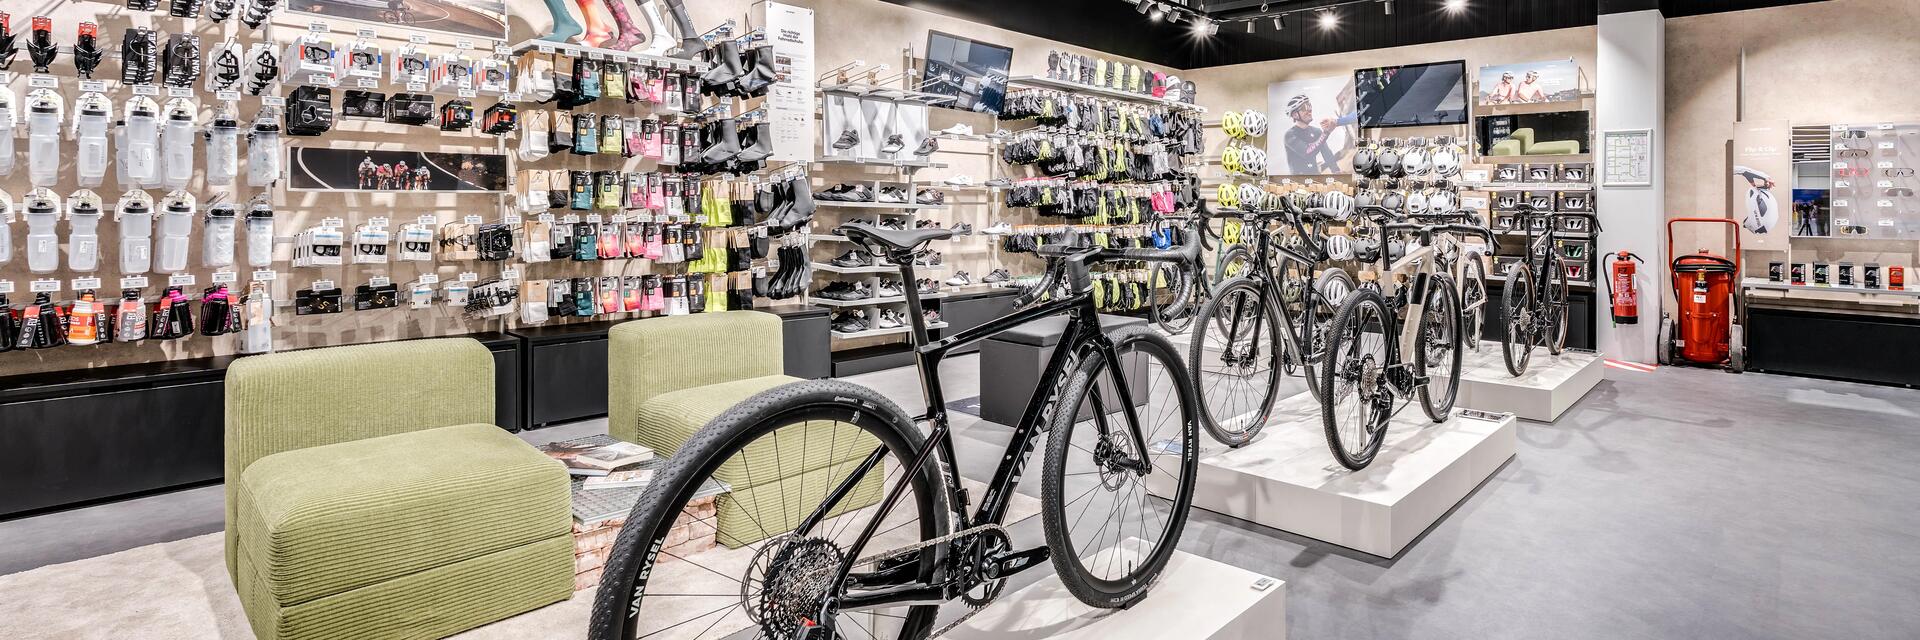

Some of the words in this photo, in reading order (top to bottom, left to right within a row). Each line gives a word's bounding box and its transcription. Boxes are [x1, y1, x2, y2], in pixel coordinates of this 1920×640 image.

[148, 56, 156, 71] VAN
[629, 586, 644, 618] VAN
[639, 536, 664, 580] RYSEL
